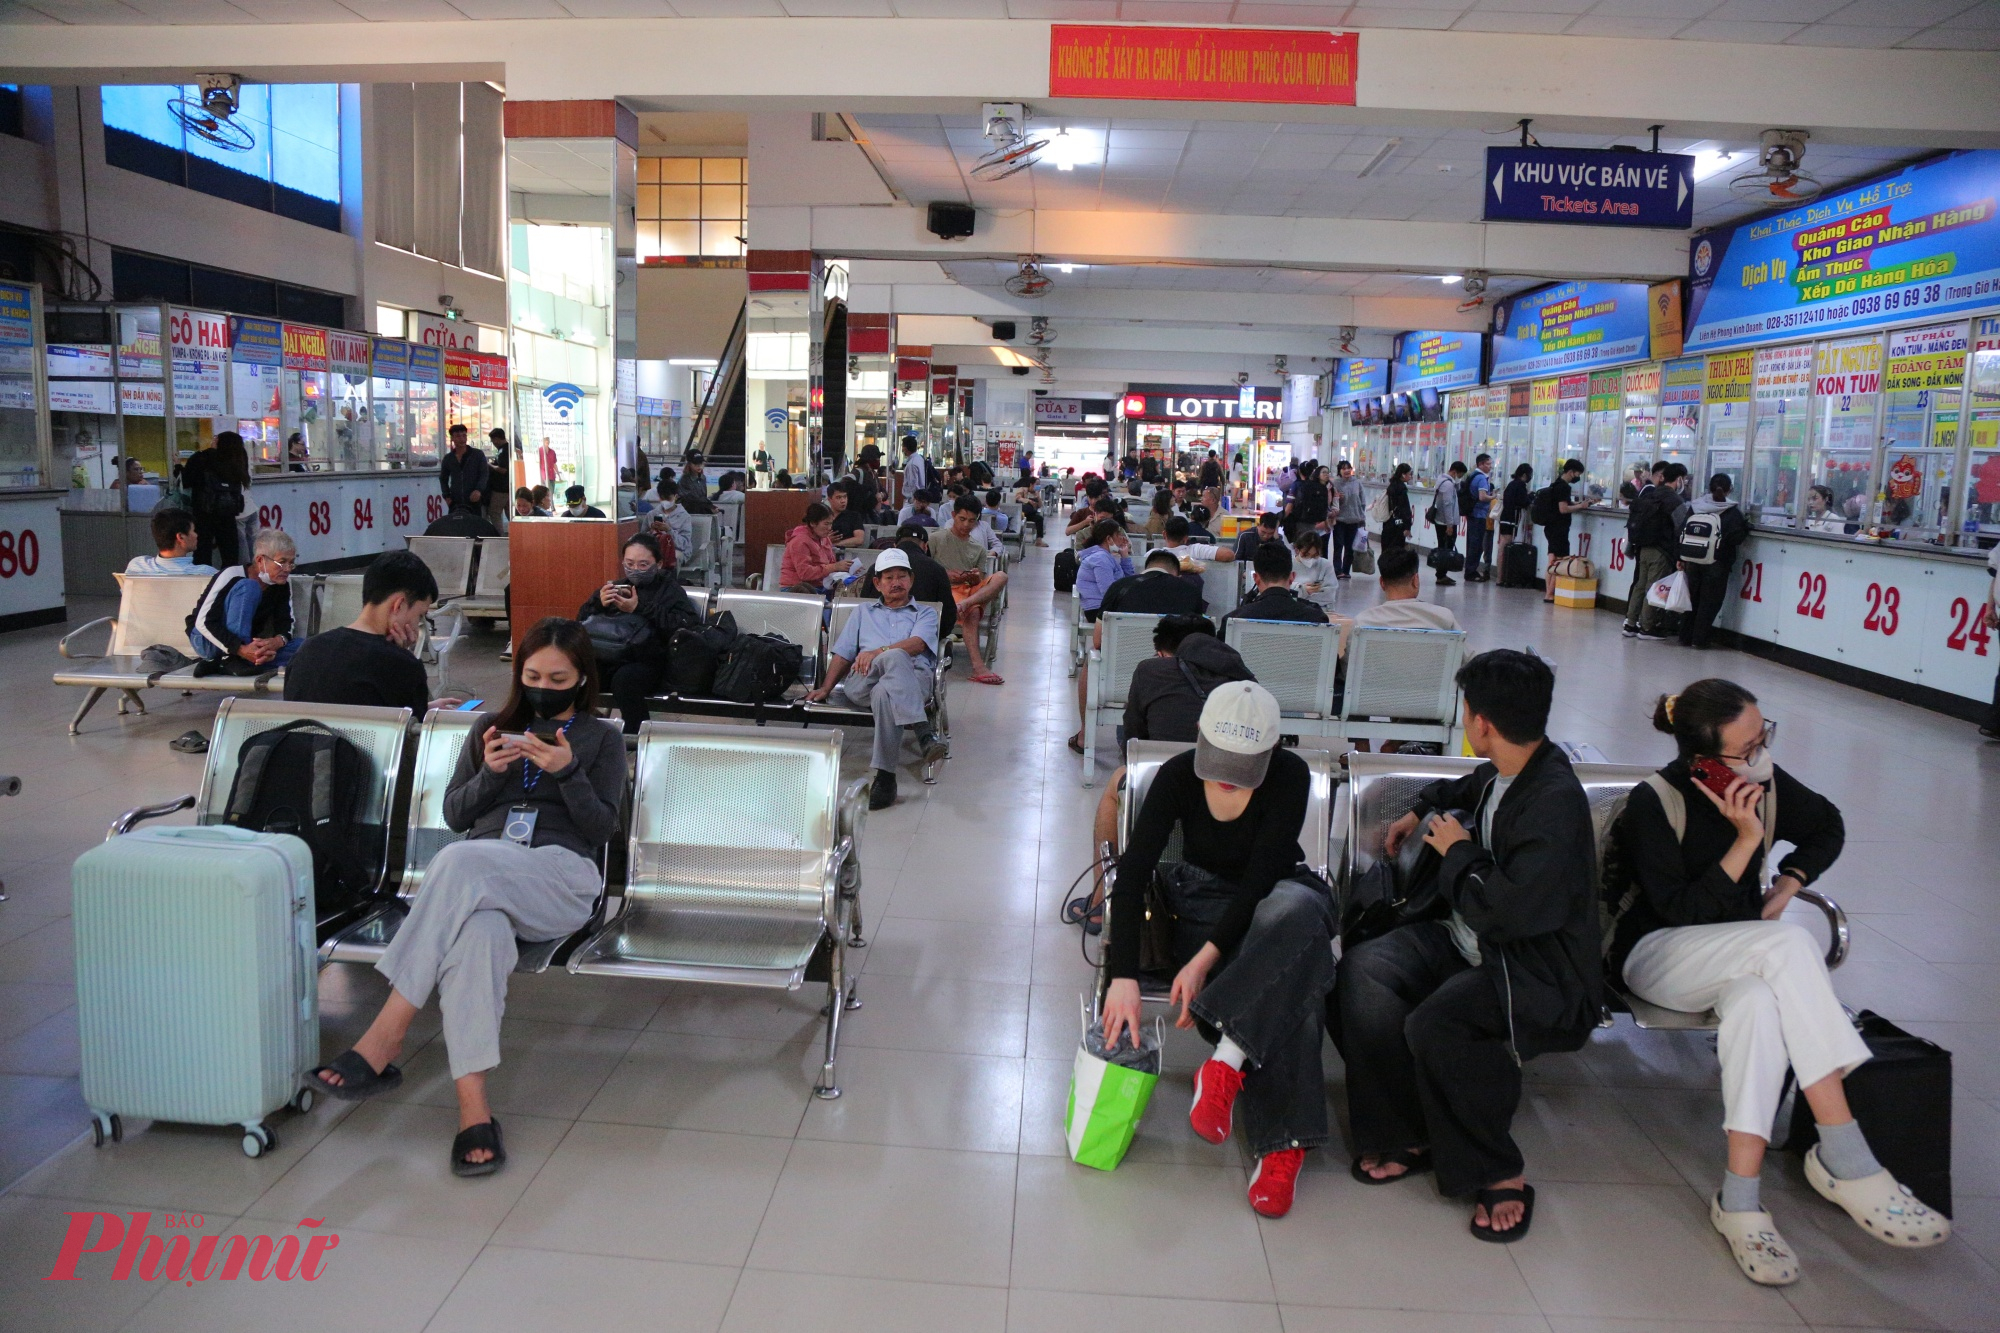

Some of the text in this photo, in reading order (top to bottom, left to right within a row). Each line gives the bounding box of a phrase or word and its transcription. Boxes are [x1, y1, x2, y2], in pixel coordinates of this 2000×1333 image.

[1058, 33, 1349, 92] KHÔNG ĐỂ XẢY RA CHÁY, NỔ LÀ HẠNH PHÚC CỦA MỌI NHÀ
[1514, 162, 1668, 191] KHU VỰC BÁN VÉ
[1541, 195, 1639, 215] Tickets Area
[1750, 224, 1772, 239] Khai
[1776, 213, 1802, 231] Thác
[1807, 206, 1831, 224] Dịch
[1837, 198, 1853, 215] Vụ
[1859, 185, 1881, 206] Hỗ
[1798, 213, 1884, 247] Quảng Cáo
[1802, 204, 1986, 263] Kho Giao Nhận Hàng
[1741, 258, 1787, 291] Dịch Vụ
[1796, 258, 1863, 283] Ẩm Thực
[1801, 259, 1949, 302] Xếp Dỡ Hàng Hóa
[1541, 300, 1577, 317] Quảng Cáo
[1543, 301, 1614, 327] Kho Giao Nhận Hàng
[1766, 308, 1825, 330] 028-35112410
[1826, 305, 1849, 321] hoặc
[1851, 294, 1881, 315] 0938
[1884, 291, 1900, 310] 69
[1903, 287, 1919, 307] 69
[1923, 284, 1940, 303] 38
[1945, 285, 1972, 301] (Trong
[1974, 279, 1990, 295] Giờ
[170, 312, 227, 348] CÔ HAI
[1553, 327, 1569, 338] Thực
[1567, 336, 1586, 347] Hàng
[1905, 333, 1920, 343] TƯ
[349, 342, 367, 364] ANH
[1818, 343, 1839, 375] TÂY
[1891, 347, 1906, 358] KON
[1907, 344, 1923, 356] TUM
[1951, 338, 1968, 350] ĐEN
[1892, 356, 1964, 374] HOÀNG TÂM
[1591, 374, 1606, 395] ĐỨC
[1626, 367, 1643, 392] QUỐC
[1816, 373, 1880, 396] KON TUM
[1902, 377, 1921, 388] SONG
[1707, 384, 1725, 402] NGỌC
[1841, 396, 1851, 411] 22
[1916, 390, 1929, 409] 23
[1035, 401, 1078, 413] CỬA E
[1724, 403, 1732, 416] 20
[309, 501, 331, 536] 83
[353, 498, 374, 530] 84
[392, 495, 410, 527] 85
[426, 495, 443, 523] 86
[0, 529, 40, 579] 80
[1578, 533, 1591, 557] 17
[1740, 559, 1763, 603] 21
[1797, 572, 1827, 620] 22
[1863, 582, 1900, 636] 23
[1947, 597, 1991, 657] 24
[1214, 721, 1261, 742] SIGNATURE
